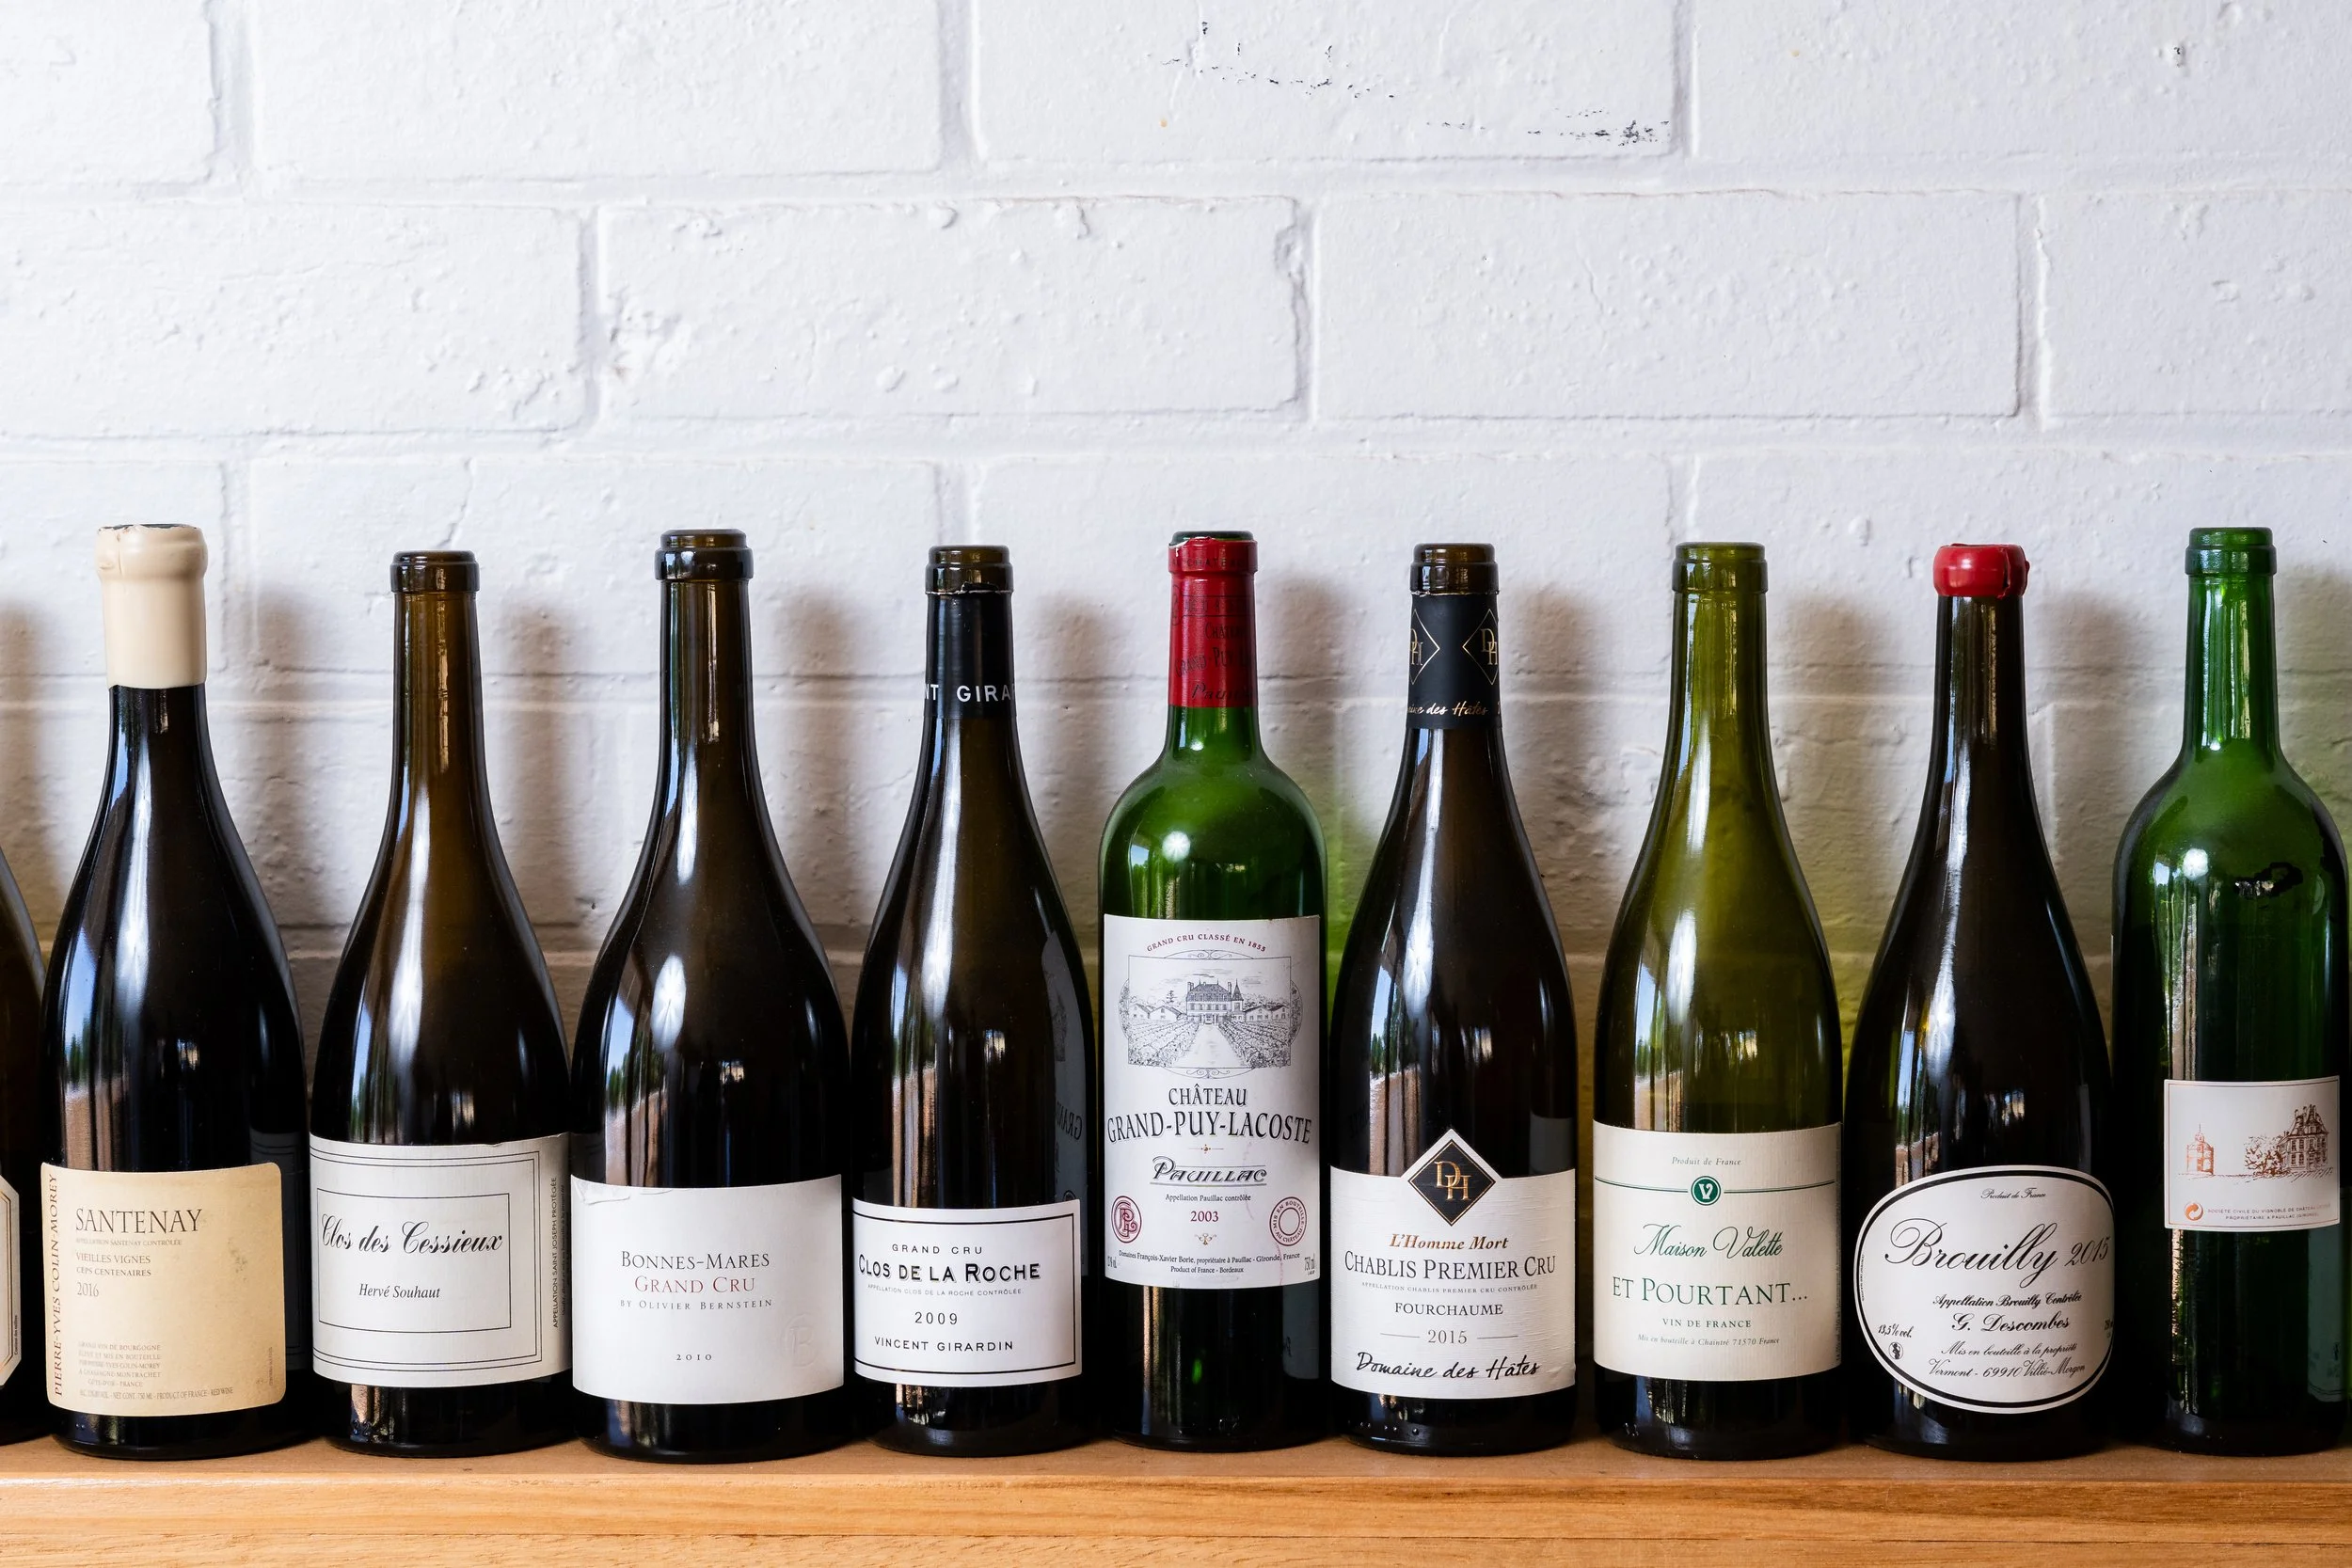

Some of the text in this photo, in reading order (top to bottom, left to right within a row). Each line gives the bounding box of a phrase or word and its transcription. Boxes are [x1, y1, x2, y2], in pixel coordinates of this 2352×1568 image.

[957, 683, 1015, 702] GIRA
[1426, 703, 1449, 715] des
[1147, 933, 1266, 952] GRAND CRU CLASSÉ EN 1855
[1168, 1084, 1248, 1106] CHÂTEAU
[1107, 1111, 1312, 1144] GRAND-PUY-LACOSTE
[1434, 1161, 1471, 1200] DH
[1166, 1194, 1199, 1202] Appellation
[1980, 1188, 2010, 1199] Produit
[2021, 1187, 2045, 1198] France
[1190, 1211, 1219, 1223] 2003
[1277, 1205, 1283, 1213] EN
[75, 1208, 202, 1234] SANTENAY
[322, 1213, 502, 1254] Clos des Cessieux
[1634, 1224, 1784, 1259] Maison Valette
[892, 1243, 983, 1255] GRAND CRU
[1470, 1236, 1509, 1249] Mort
[76, 1252, 151, 1264] VIEILLES VIGNES
[621, 1251, 770, 1270] BONNES-MARES
[1885, 1217, 2058, 1289] Brouilly
[2064, 1236, 2111, 1267] 2015
[94, 1268, 151, 1276] CENTENAIRES
[858, 1255, 1041, 1283] CLOS DE LA ROCHE
[1345, 1251, 1556, 1279] CHABLIS PREMIER CRU
[49, 1174, 62, 1396] PIERRE-YVES COLIN-MOREY
[77, 1282, 99, 1297] 2016
[359, 1283, 440, 1299] Hervé Souhaut
[635, 1275, 755, 1293] GRAND CRU
[1362, 1282, 1404, 1291] APPELLATION
[1498, 1284, 1537, 1292] CONTRÔLÉE
[1613, 1277, 1634, 1298] ET
[639, 1300, 691, 1309] OLIVIER
[700, 1300, 773, 1309] BERNSTEIN
[1932, 1291, 2081, 1309] Appellation Brouilly Contrôlée
[1394, 1303, 1503, 1315] FOURCHAUME
[914, 1311, 958, 1324] 2009
[1688, 1319, 1701, 1327] DE
[1707, 1319, 1752, 1328] FRANCE
[1952, 1311, 2070, 1332] G. Descombes
[1427, 1330, 1468, 1345] 2015
[1899, 1326, 1914, 1338] vol.
[875, 1336, 1013, 1351] VINCENT GIRARDIN
[1660, 1336, 1688, 1345] bouteille
[1942, 1341, 1966, 1355] Mis
[1983, 1343, 2021, 1356] bouteille
[2032, 1343, 2041, 1354] la
[2040, 1343, 2077, 1358] propriété
[675, 1354, 712, 1362] 2010
[1357, 1353, 1540, 1380] Domaine des Hâtes
[1929, 1357, 2085, 1379] Vermont 69910 Villié-Morgon
